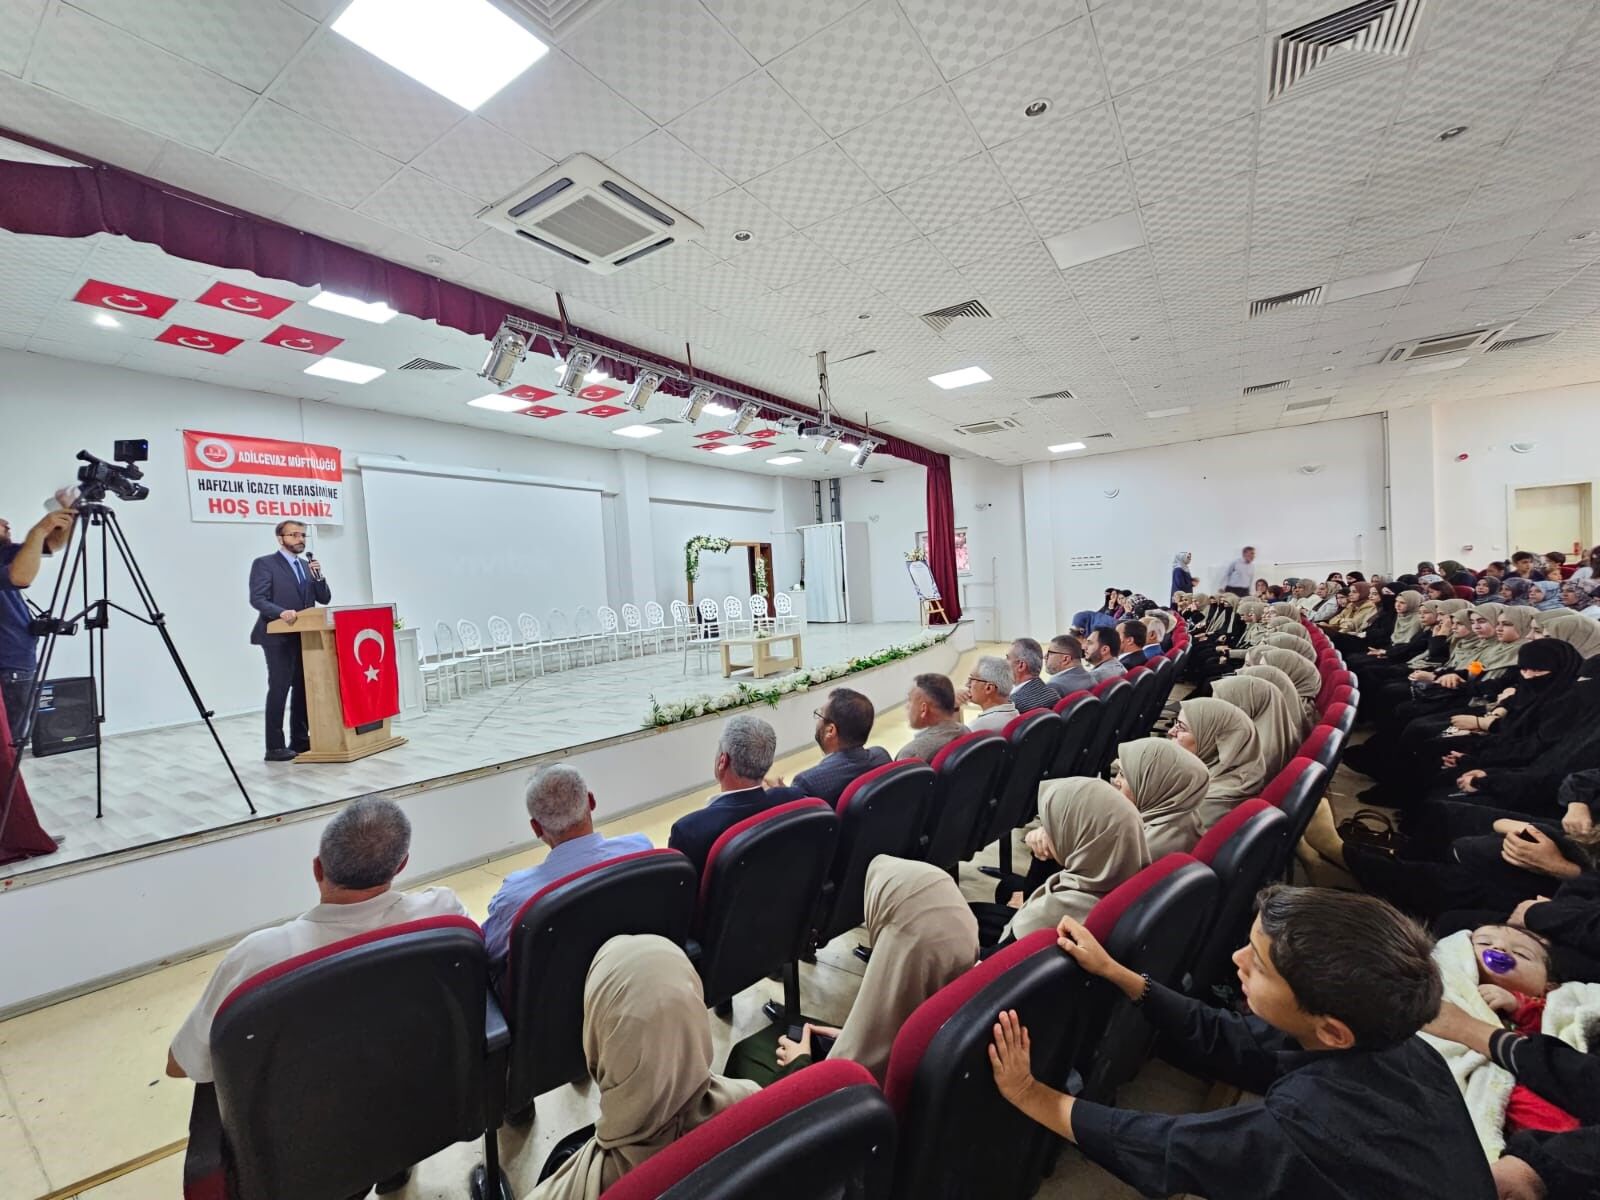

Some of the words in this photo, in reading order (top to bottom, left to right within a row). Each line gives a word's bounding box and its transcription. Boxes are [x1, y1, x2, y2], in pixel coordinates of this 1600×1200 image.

[238, 449, 287, 466] ADİLCEVAZ
[198, 478, 244, 493] HAFIZLIK
[247, 481, 279, 495] İCAZET
[283, 484, 338, 499] MERASİMİNE
[208, 497, 250, 518] HOŞ
[255, 499, 332, 518] GELDİNİZ
